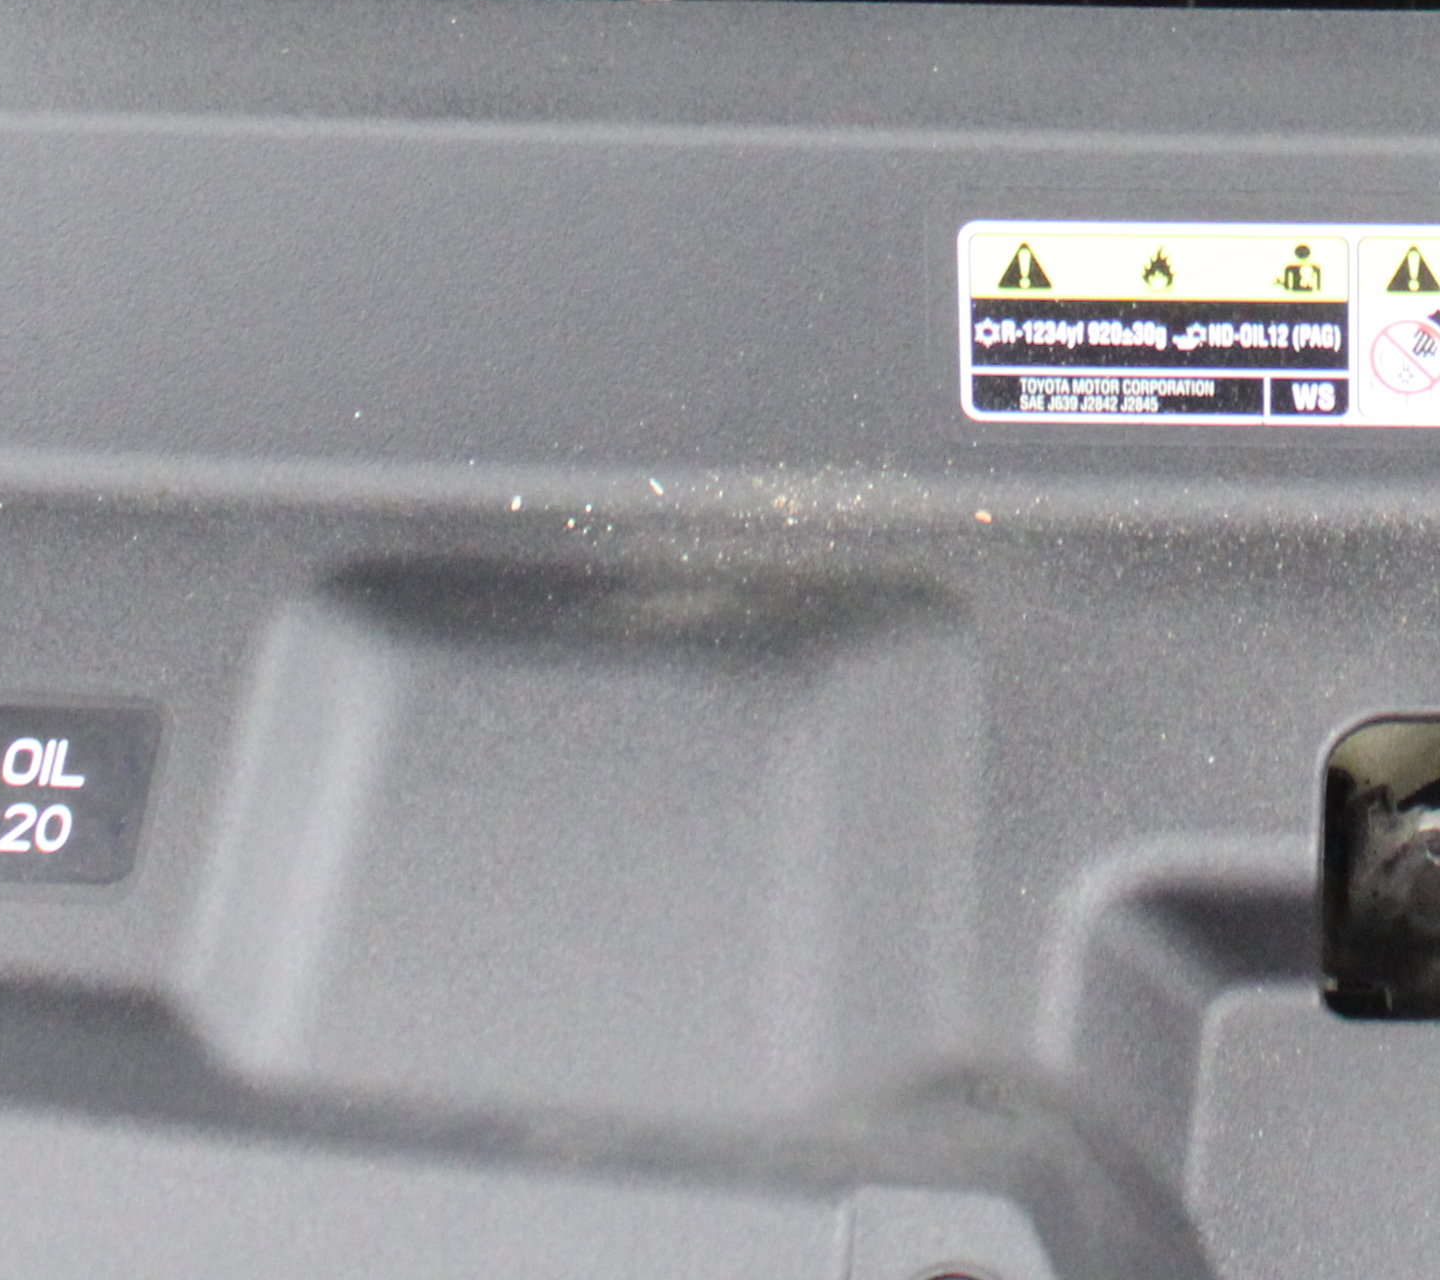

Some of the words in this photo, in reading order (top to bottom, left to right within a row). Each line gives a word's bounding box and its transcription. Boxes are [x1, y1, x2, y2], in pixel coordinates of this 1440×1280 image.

[1000, 319, 1084, 350] R-1234yf
[1086, 319, 1168, 352] 920±30g
[1291, 323, 1342, 354] (PAG)
[1018, 377, 1071, 395] TOYOTA
[1072, 377, 1120, 396] MOTOR
[1121, 378, 1216, 398] CORPORATION
[1291, 381, 1336, 413] WS
[1018, 395, 1046, 412] SAE
[1047, 395, 1079, 413] J639
[1079, 395, 1119, 413] J2842
[1119, 395, 1160, 414] J2845
[0, 737, 86, 788] OIL
